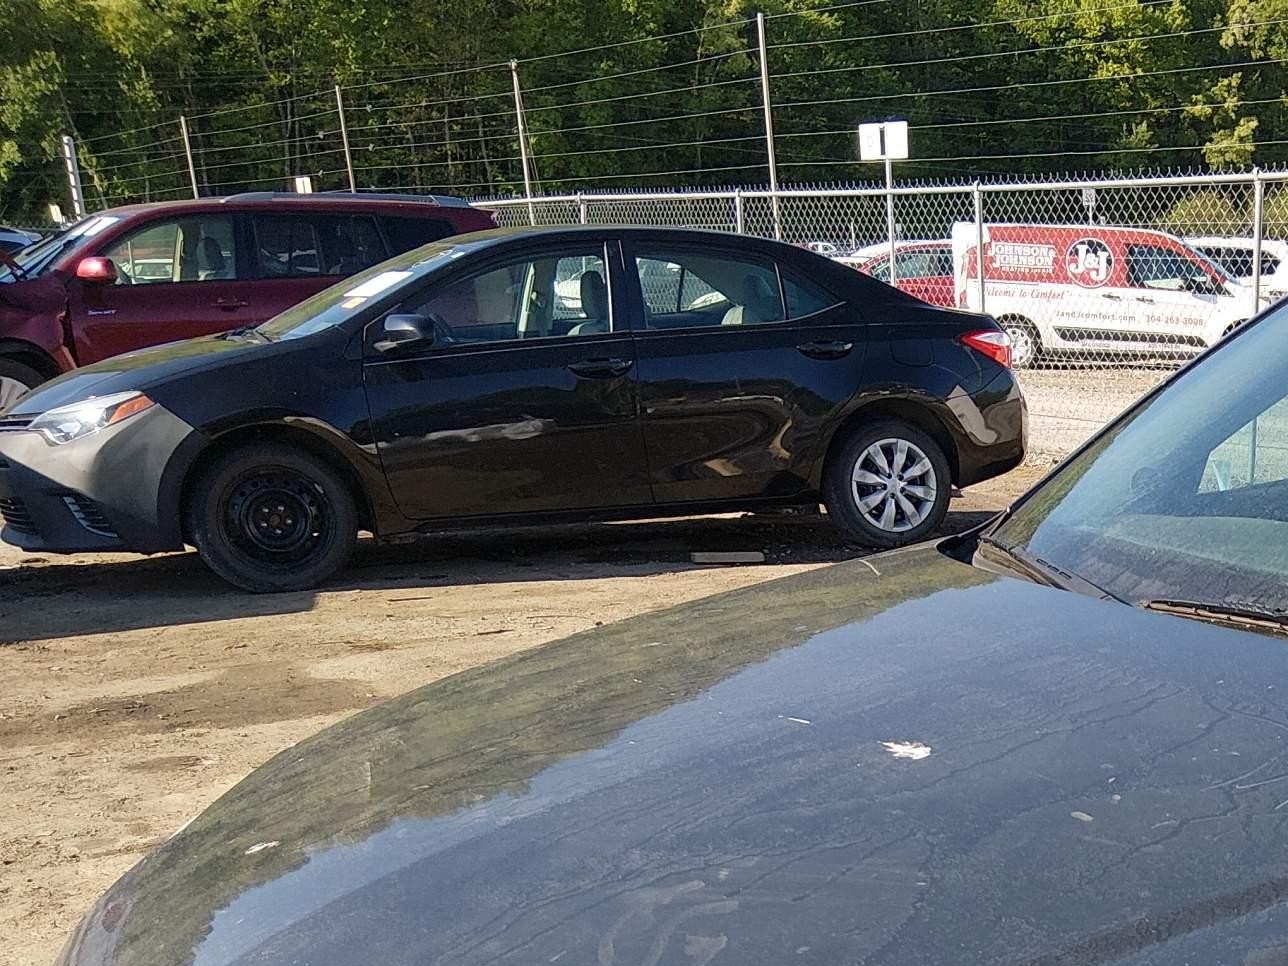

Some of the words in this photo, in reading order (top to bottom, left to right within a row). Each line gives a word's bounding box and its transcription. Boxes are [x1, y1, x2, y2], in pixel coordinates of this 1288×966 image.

[987, 242, 1049, 256] JOHNSON
[992, 254, 1053, 267] JOHNSON
[1069, 244, 1109, 281] J&J
